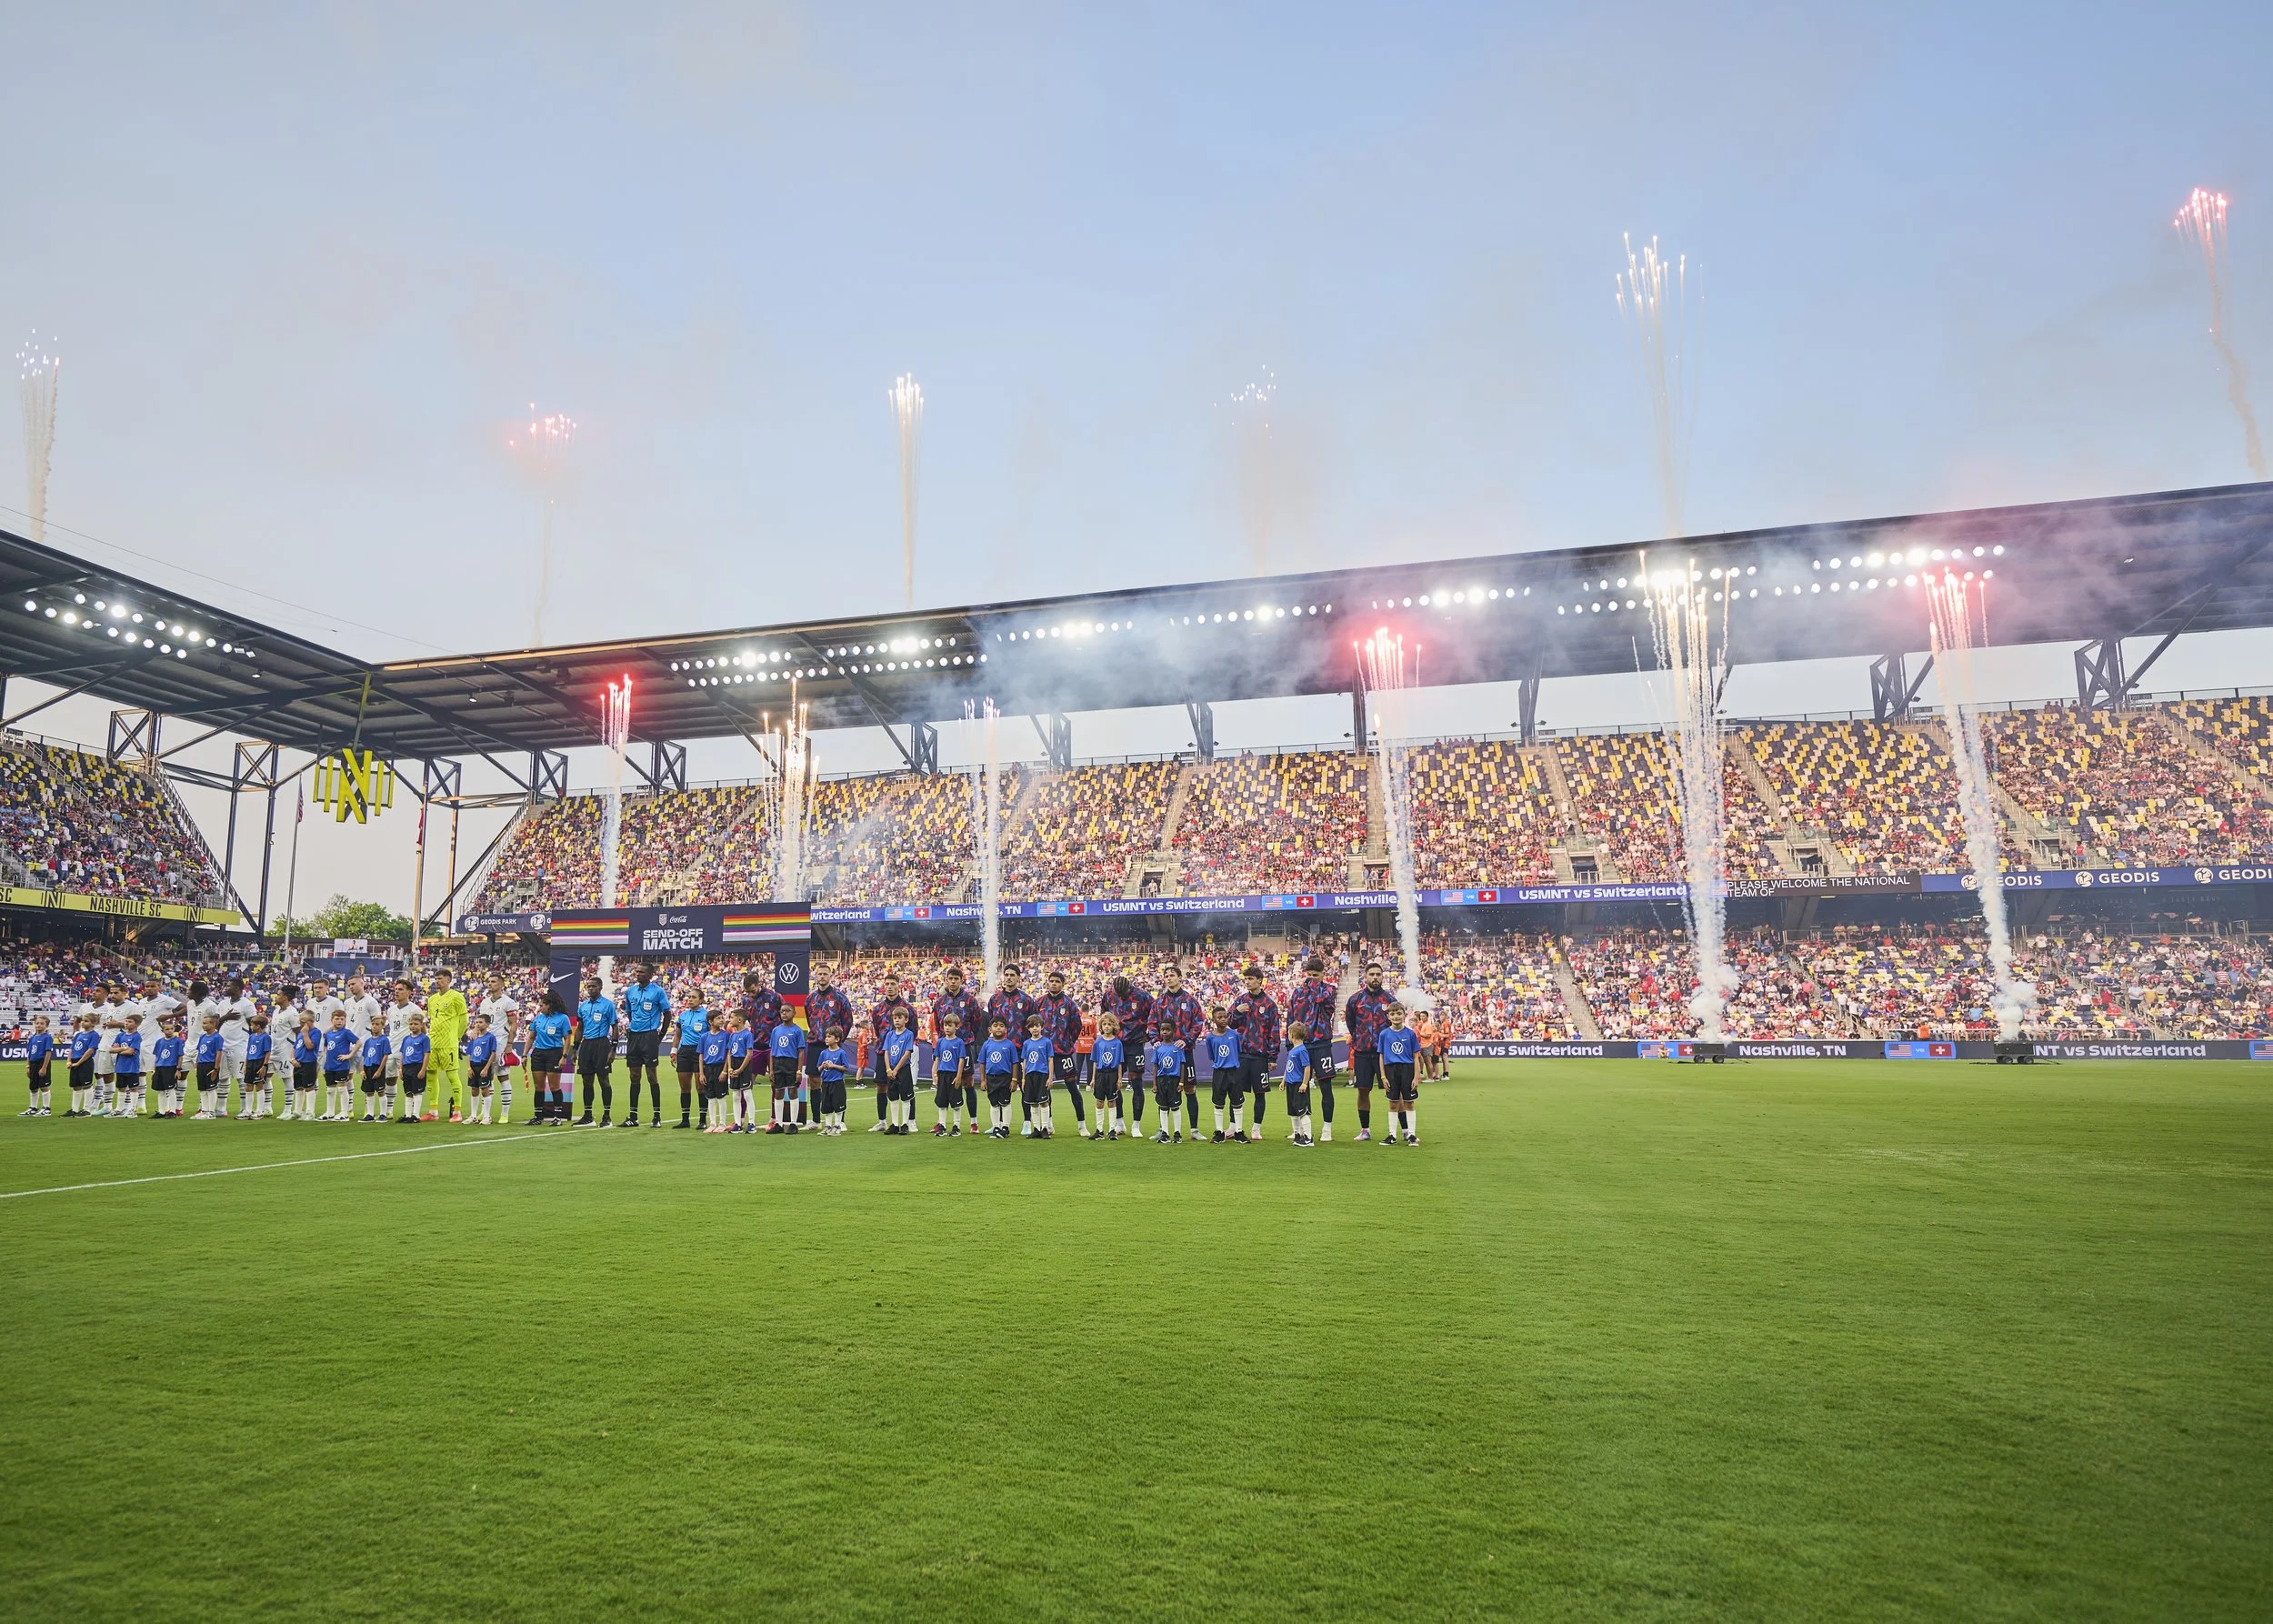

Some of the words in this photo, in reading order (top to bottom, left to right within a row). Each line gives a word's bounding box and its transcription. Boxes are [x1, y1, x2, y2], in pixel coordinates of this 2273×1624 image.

[2098, 871, 2160, 884] GEODIS
[2218, 868, 2273, 880] GEODI
[1727, 880, 1768, 890] PLEASE
[1771, 878, 1827, 888] WELCOME
[1829, 878, 1852, 887] THE
[1854, 876, 1910, 887] NATIONAL
[1519, 888, 1571, 900] USMNT
[1574, 890, 1591, 899] vs
[1593, 885, 1687, 898] Switzerland
[1727, 888, 1757, 897] TEAM
[1760, 887, 1775, 897] OF
[90, 897, 145, 917] NASHVILLE
[149, 904, 162, 917] SC
[946, 906, 1004, 917] Nashv,
[1005, 905, 1022, 915] TN
[1103, 902, 1146, 912] USMNT
[1149, 902, 1163, 911] vs
[1166, 898, 1245, 909] Switzerland
[811, 909, 870, 920] witzerland
[643, 927, 704, 938] SEND-OFF
[643, 937, 703, 950] MATCH
[191, 1017, 195, 1026] 9
[350, 1014, 355, 1023] 4
[393, 1020, 401, 1030] 18
[1081, 1025, 1091, 1037] 34
[1487, 1047, 1506, 1056] vs
[1508, 1045, 1603, 1056] Switzerland
[1738, 1045, 1820, 1058] Nashville,
[1823, 1045, 1847, 1056] TN
[2064, 1047, 2086, 1057] vs
[2089, 1044, 2207, 1057] Switzerland
[448, 1052, 454, 1062] 1
[1061, 1057, 1074, 1069] 20
[1136, 1055, 1145, 1066] 22
[1321, 1056, 1332, 1069] 27
[279, 1060, 289, 1071] 24
[1187, 1066, 1195, 1078] 11
[1260, 1072, 1269, 1084] 21
